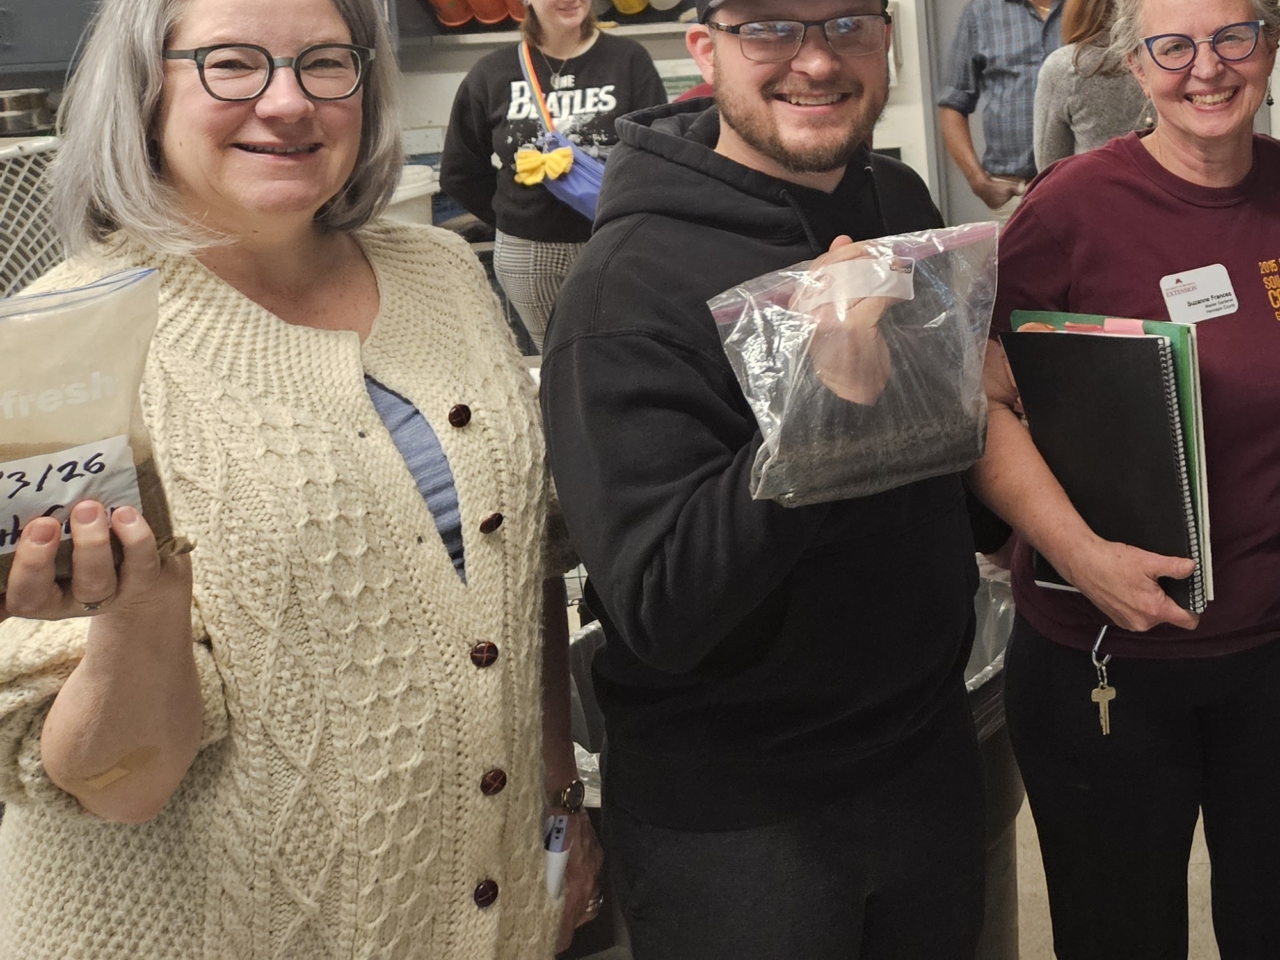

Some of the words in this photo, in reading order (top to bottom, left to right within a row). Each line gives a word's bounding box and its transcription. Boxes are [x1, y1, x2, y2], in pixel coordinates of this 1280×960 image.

[1258, 260, 1278, 274] 2015
[1166, 285, 1198, 298] EXTENSION
[1186, 297, 1210, 307] Suzanne
[1210, 292, 1232, 300] Frances
[0, 372, 114, 420] fresh
